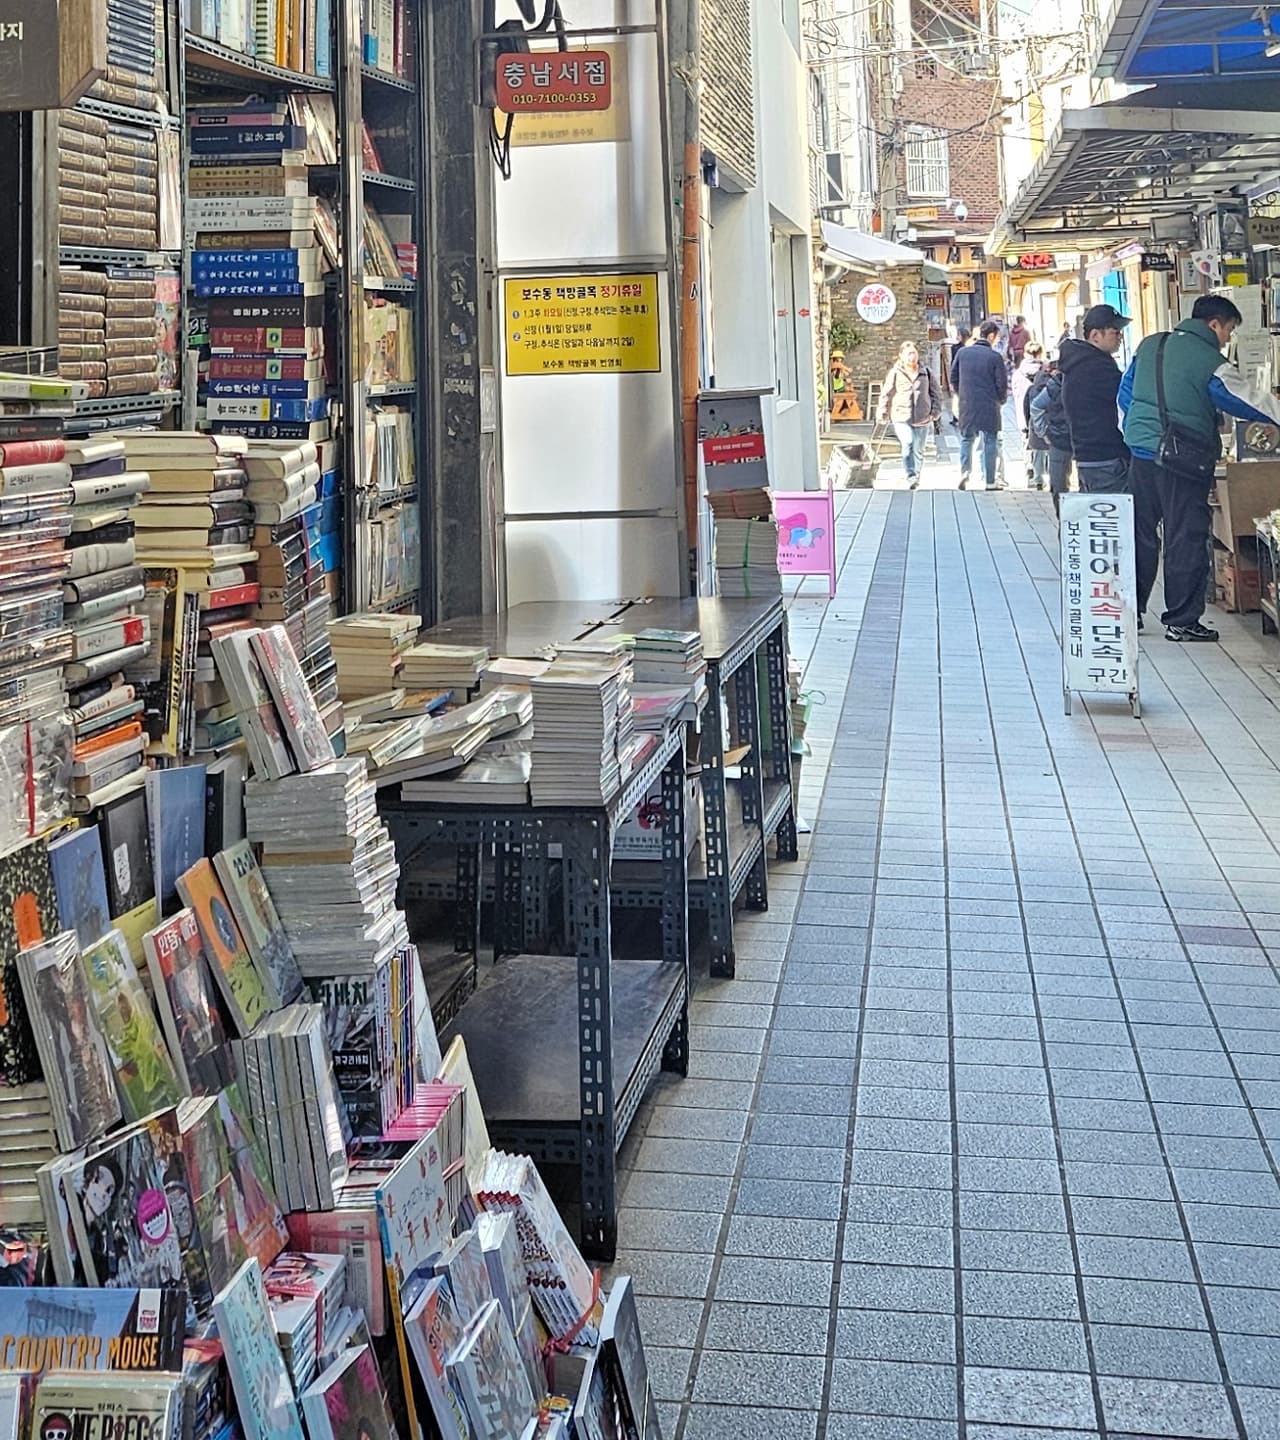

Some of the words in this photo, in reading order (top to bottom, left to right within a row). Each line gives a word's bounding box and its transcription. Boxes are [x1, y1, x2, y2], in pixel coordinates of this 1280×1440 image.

[503, 60, 607, 89] 충남서점
[511, 92, 598, 106] 010-7100-0353
[521, 286, 553, 301] 보수동
[556, 285, 597, 300] 책방골목
[599, 283, 642, 298] 정기휴일
[1087, 501, 1122, 577] 오토바이
[1090, 624, 1125, 664] 단속
[1086, 667, 1129, 685] 구간
[107, 1333, 161, 1371] MOUSE
